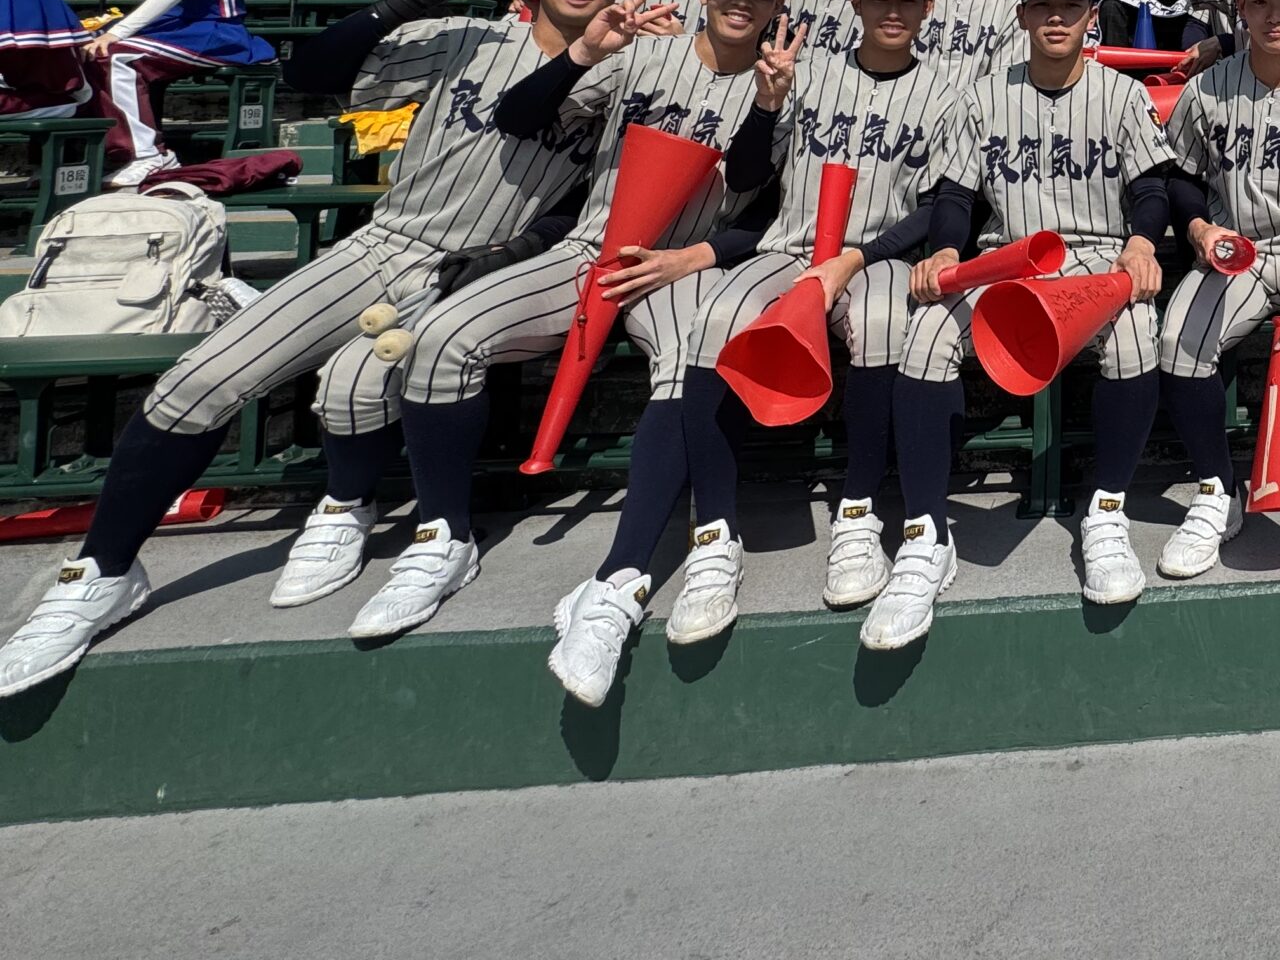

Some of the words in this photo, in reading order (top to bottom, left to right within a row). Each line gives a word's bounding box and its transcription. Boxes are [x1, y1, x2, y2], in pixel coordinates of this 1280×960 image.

[911, 18, 998, 58] 賀気比
[797, 107, 930, 169] 敦賀気比
[981, 134, 1121, 185] 敦賀気比
[60, 169, 87, 183] 18段
